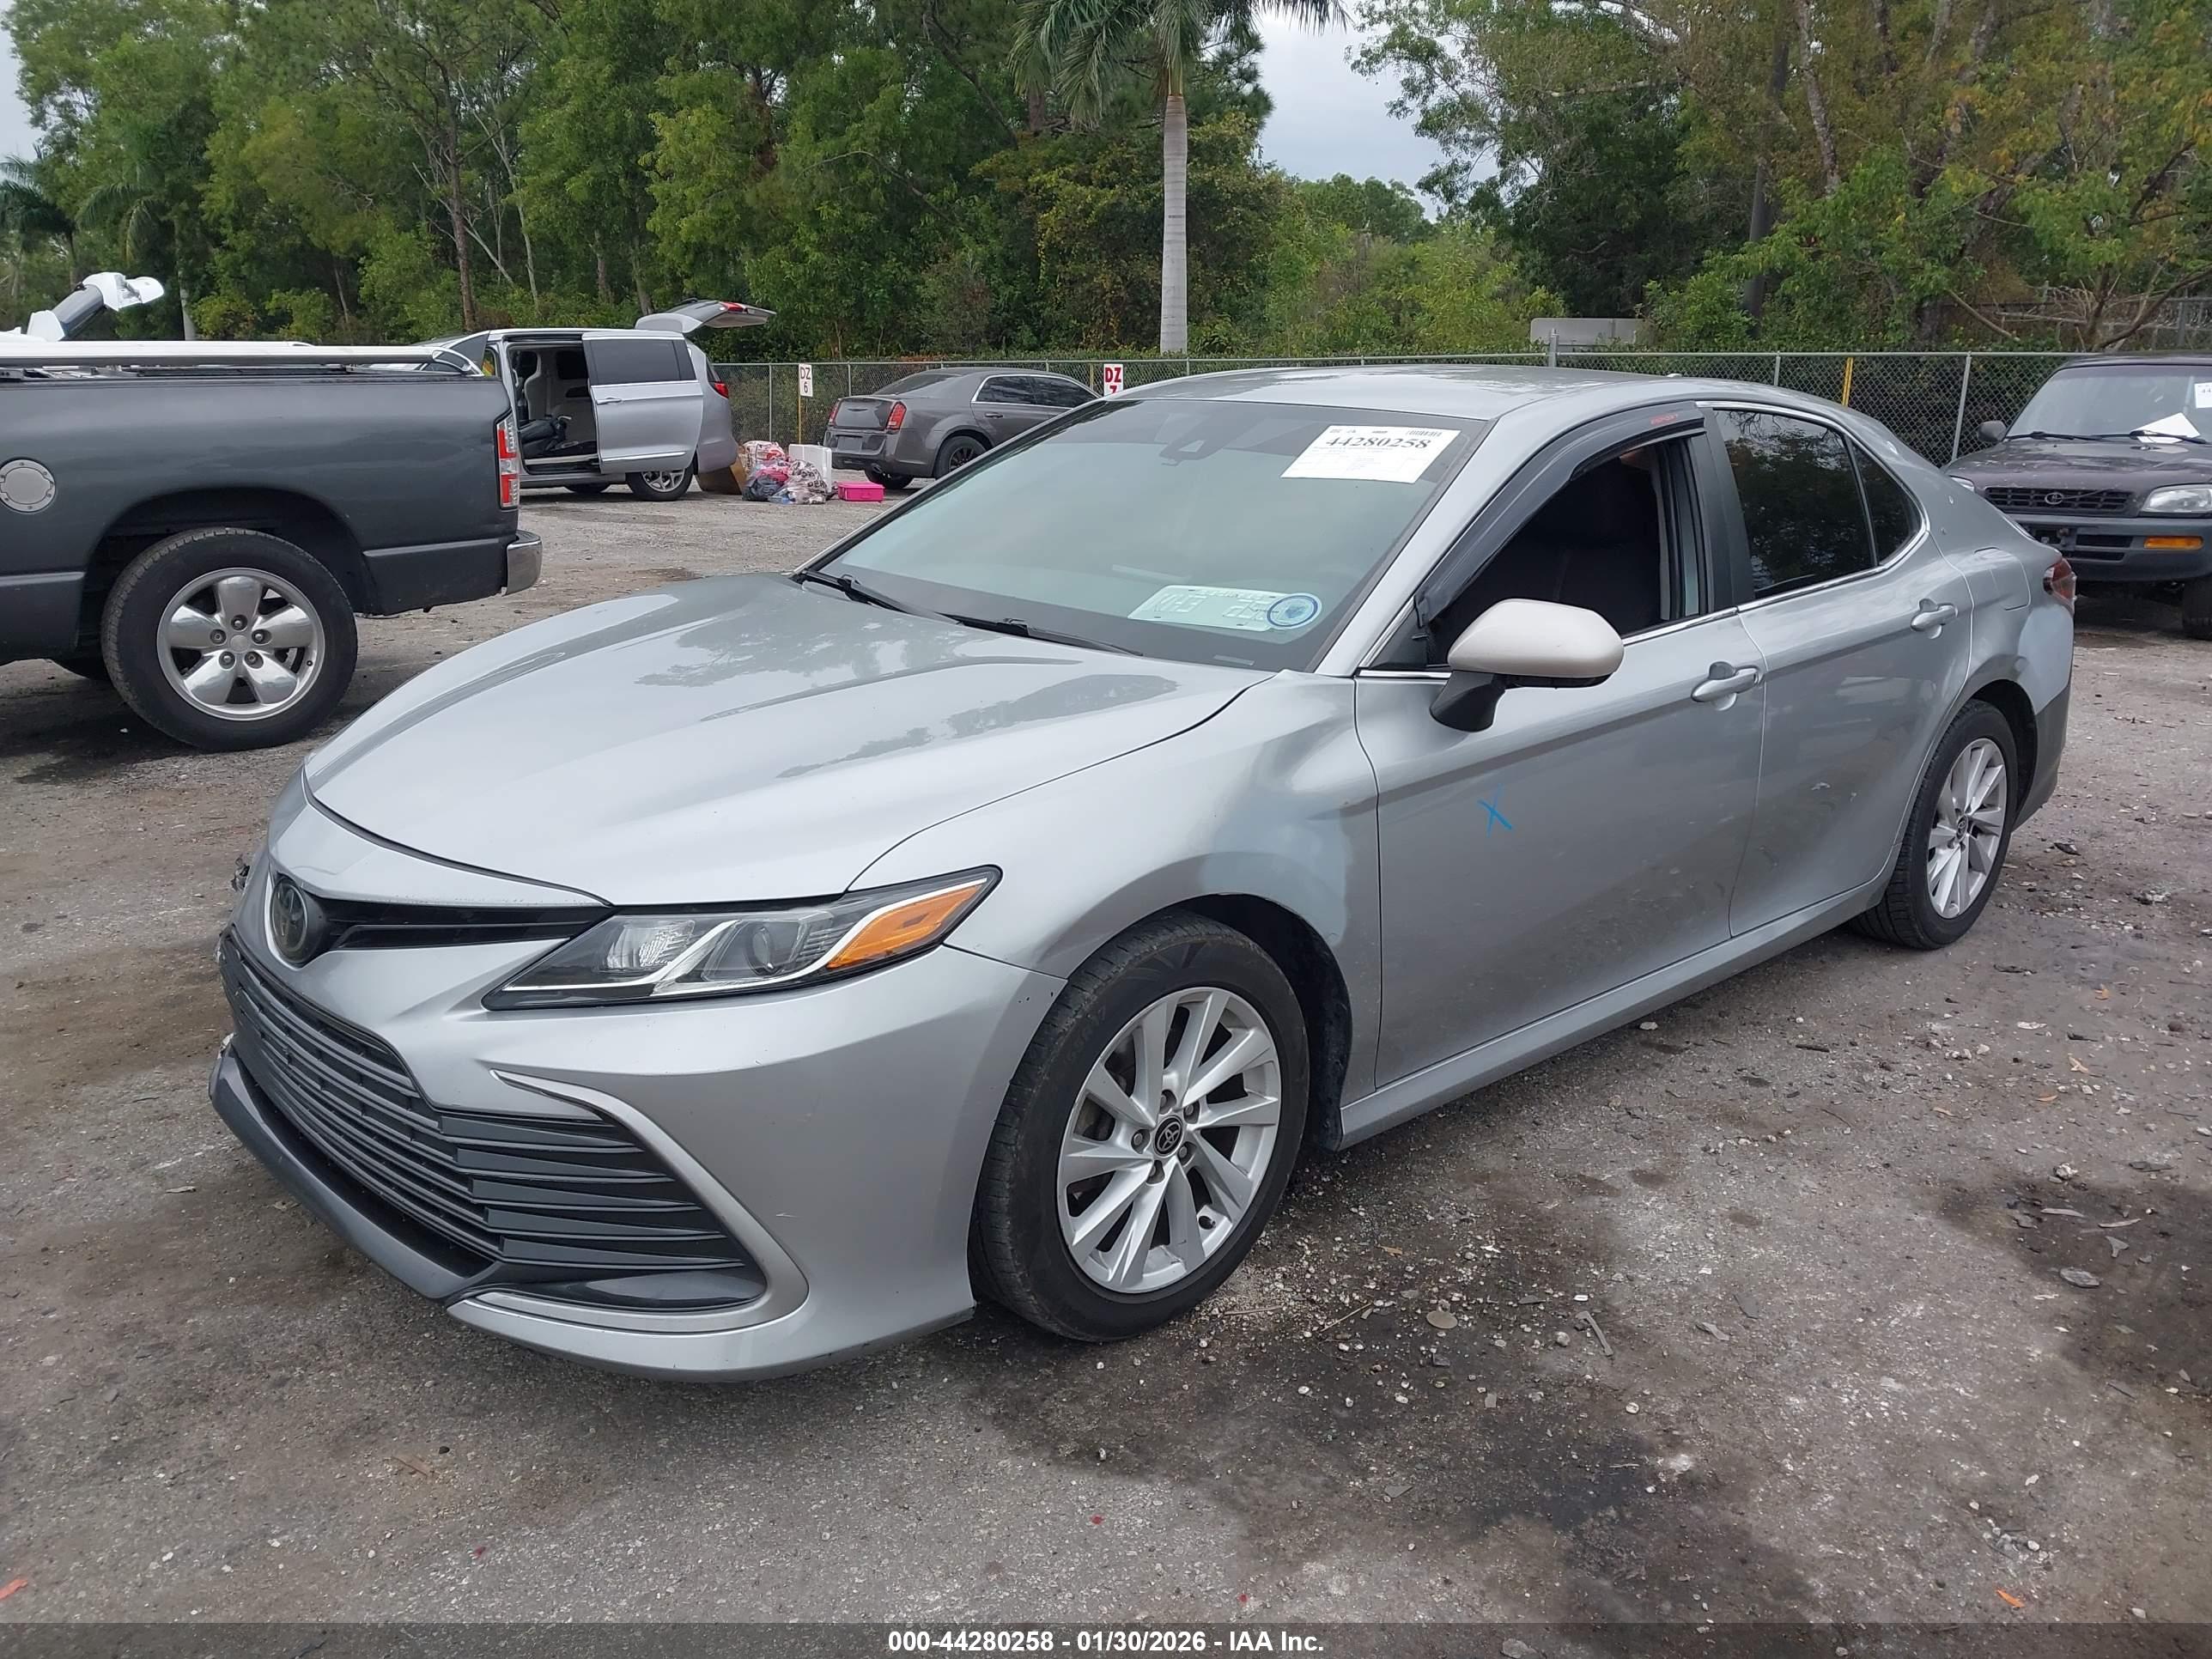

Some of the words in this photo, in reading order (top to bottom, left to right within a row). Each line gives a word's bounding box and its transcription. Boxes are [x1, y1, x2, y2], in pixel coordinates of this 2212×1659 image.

[799, 367, 811, 380] DZ
[1105, 368, 1121, 383] DZ
[804, 381, 808, 393] 6
[1326, 436, 1432, 449] 44280258
